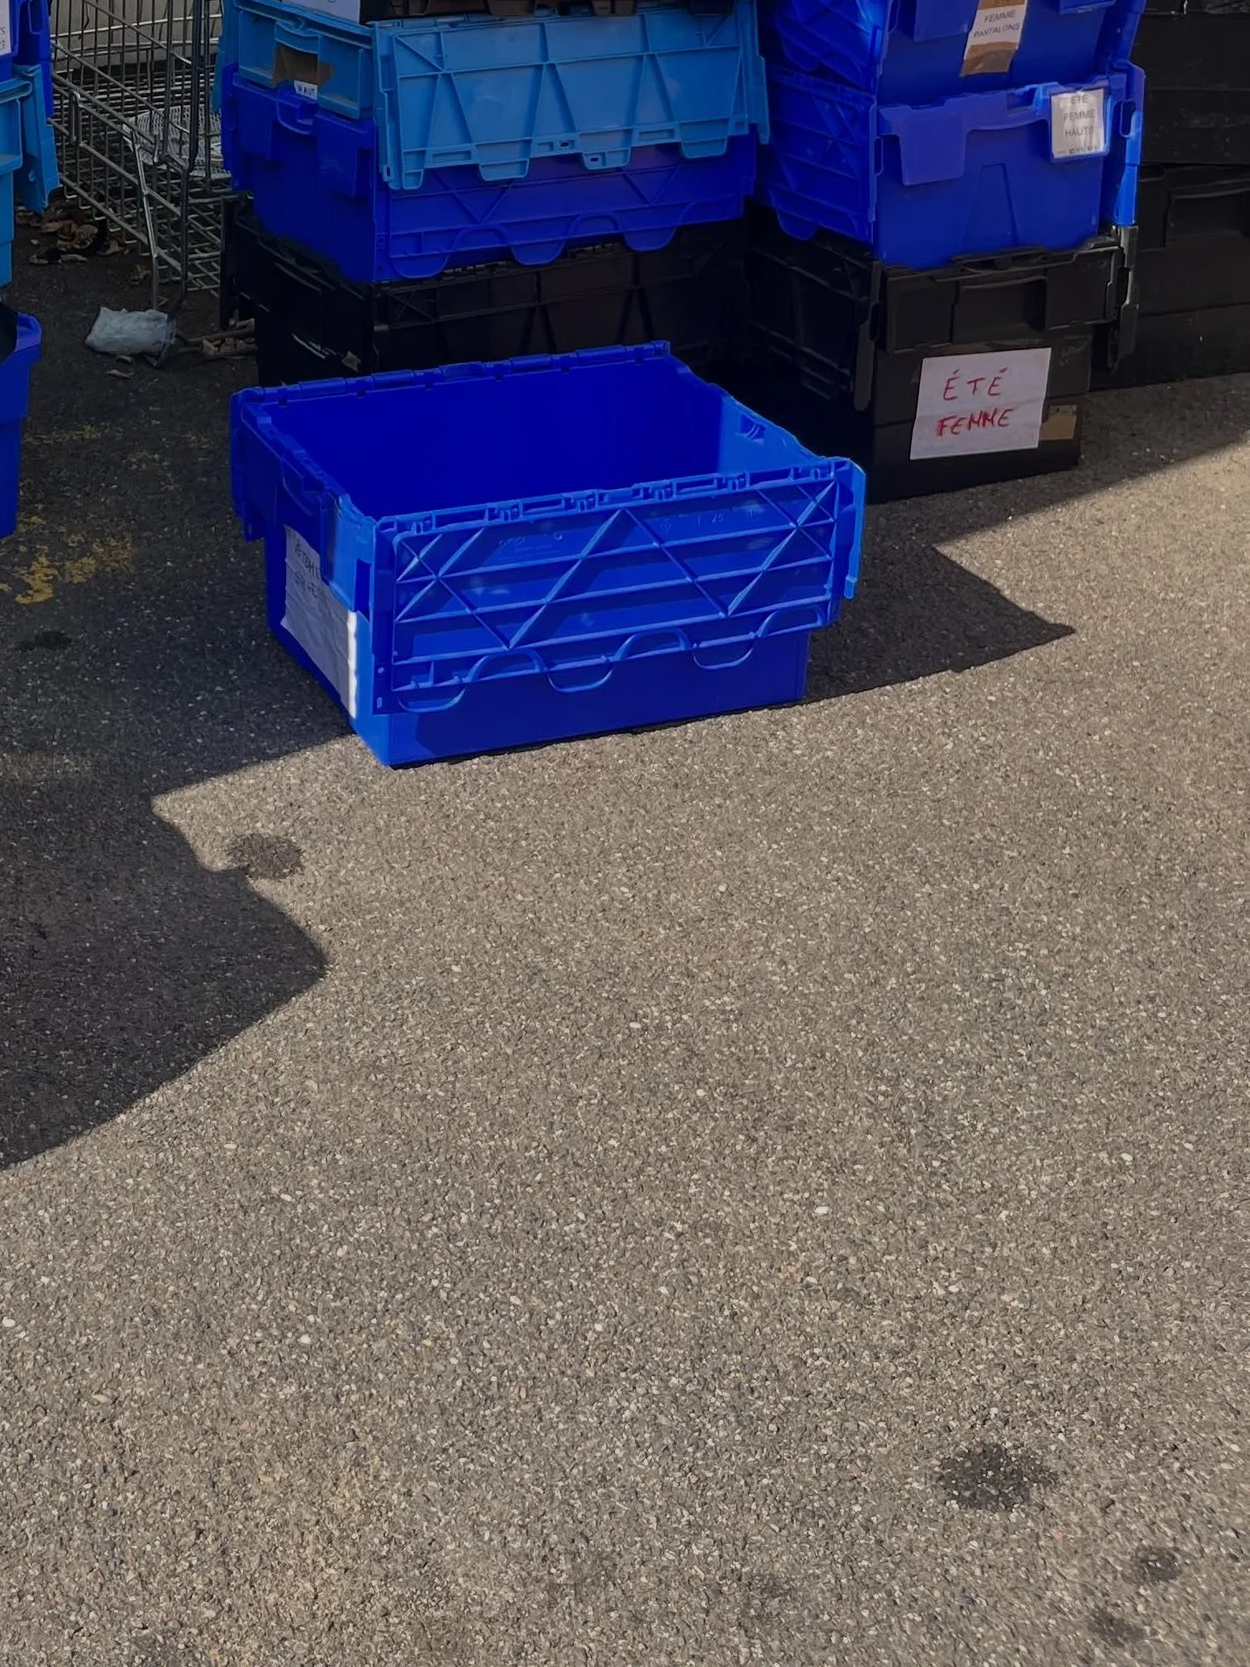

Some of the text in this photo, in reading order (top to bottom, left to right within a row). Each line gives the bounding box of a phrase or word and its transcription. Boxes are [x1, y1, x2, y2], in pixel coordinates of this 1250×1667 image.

[983, 10, 1016, 23] FEMME
[972, 22, 1021, 38] PANTALONS
[1063, 109, 1096, 122] FEMME
[1064, 125, 1094, 139] HAUTS
[942, 366, 1008, 402] ÉTÉ
[934, 407, 1014, 437] FEMME
